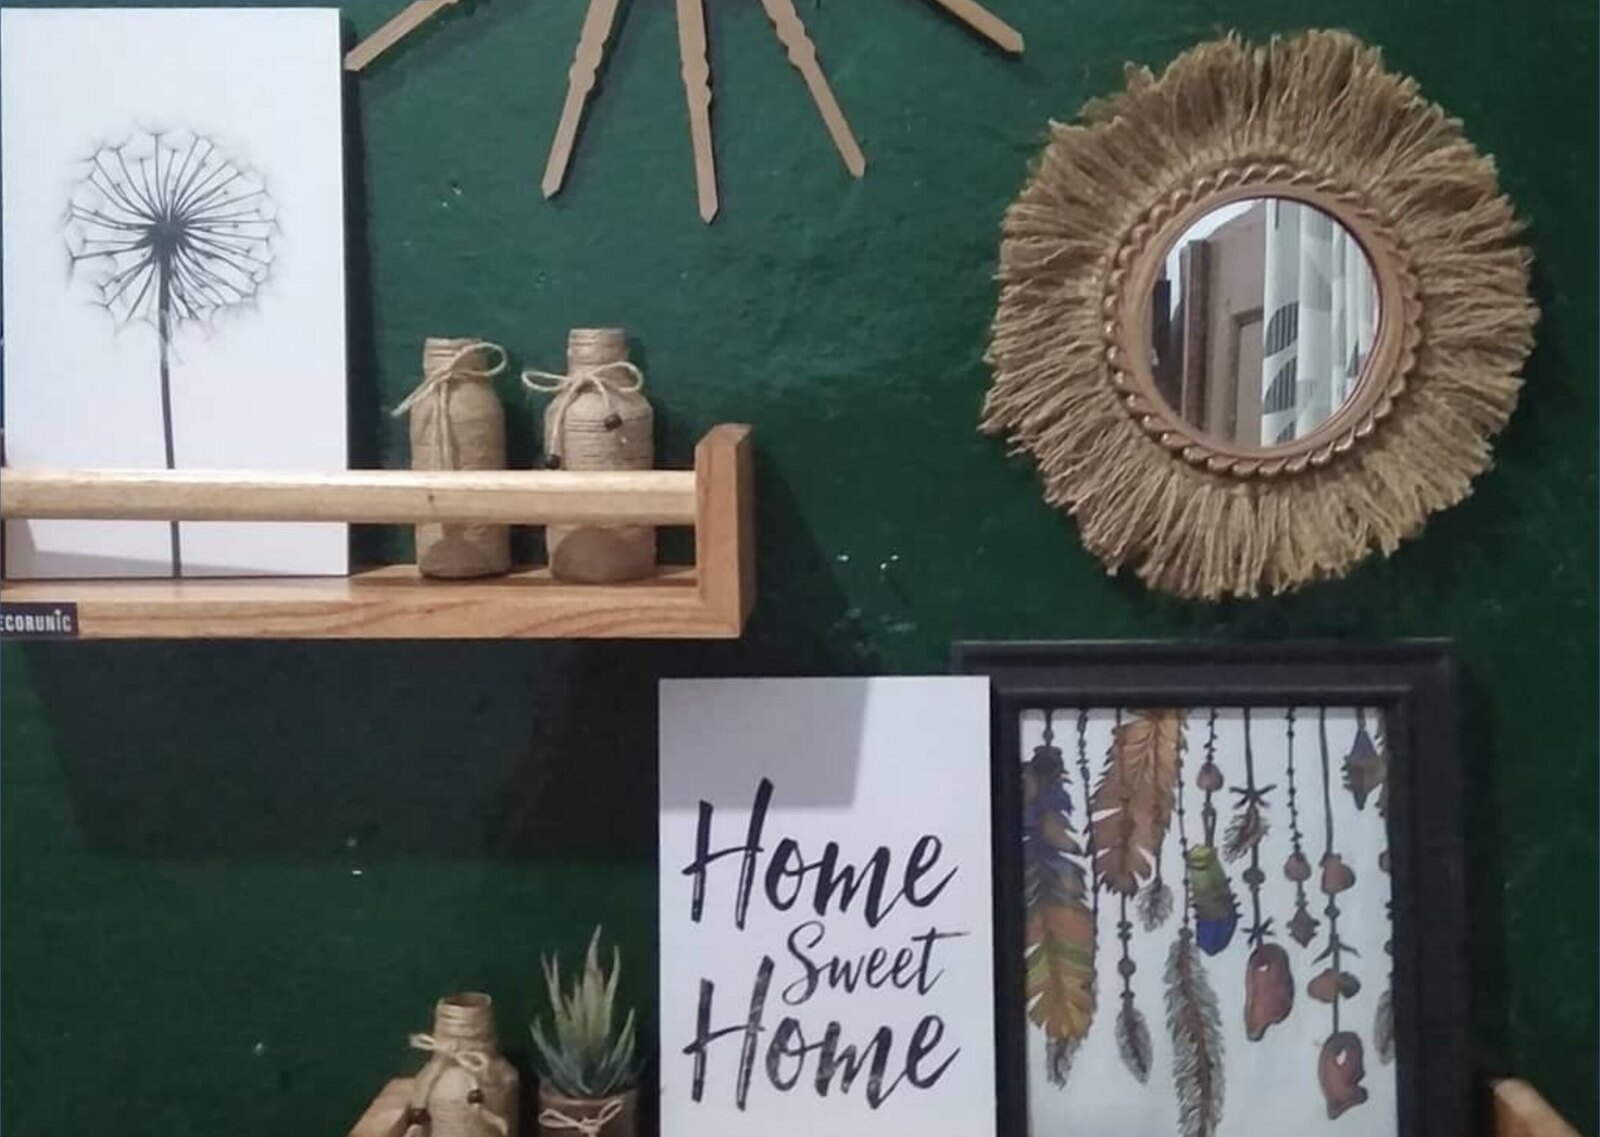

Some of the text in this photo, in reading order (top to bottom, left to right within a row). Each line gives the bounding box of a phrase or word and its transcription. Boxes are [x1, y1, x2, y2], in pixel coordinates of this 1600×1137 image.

[682, 776, 959, 930] Home
[682, 955, 960, 1111] Home
[782, 921, 970, 1006] Sweet
